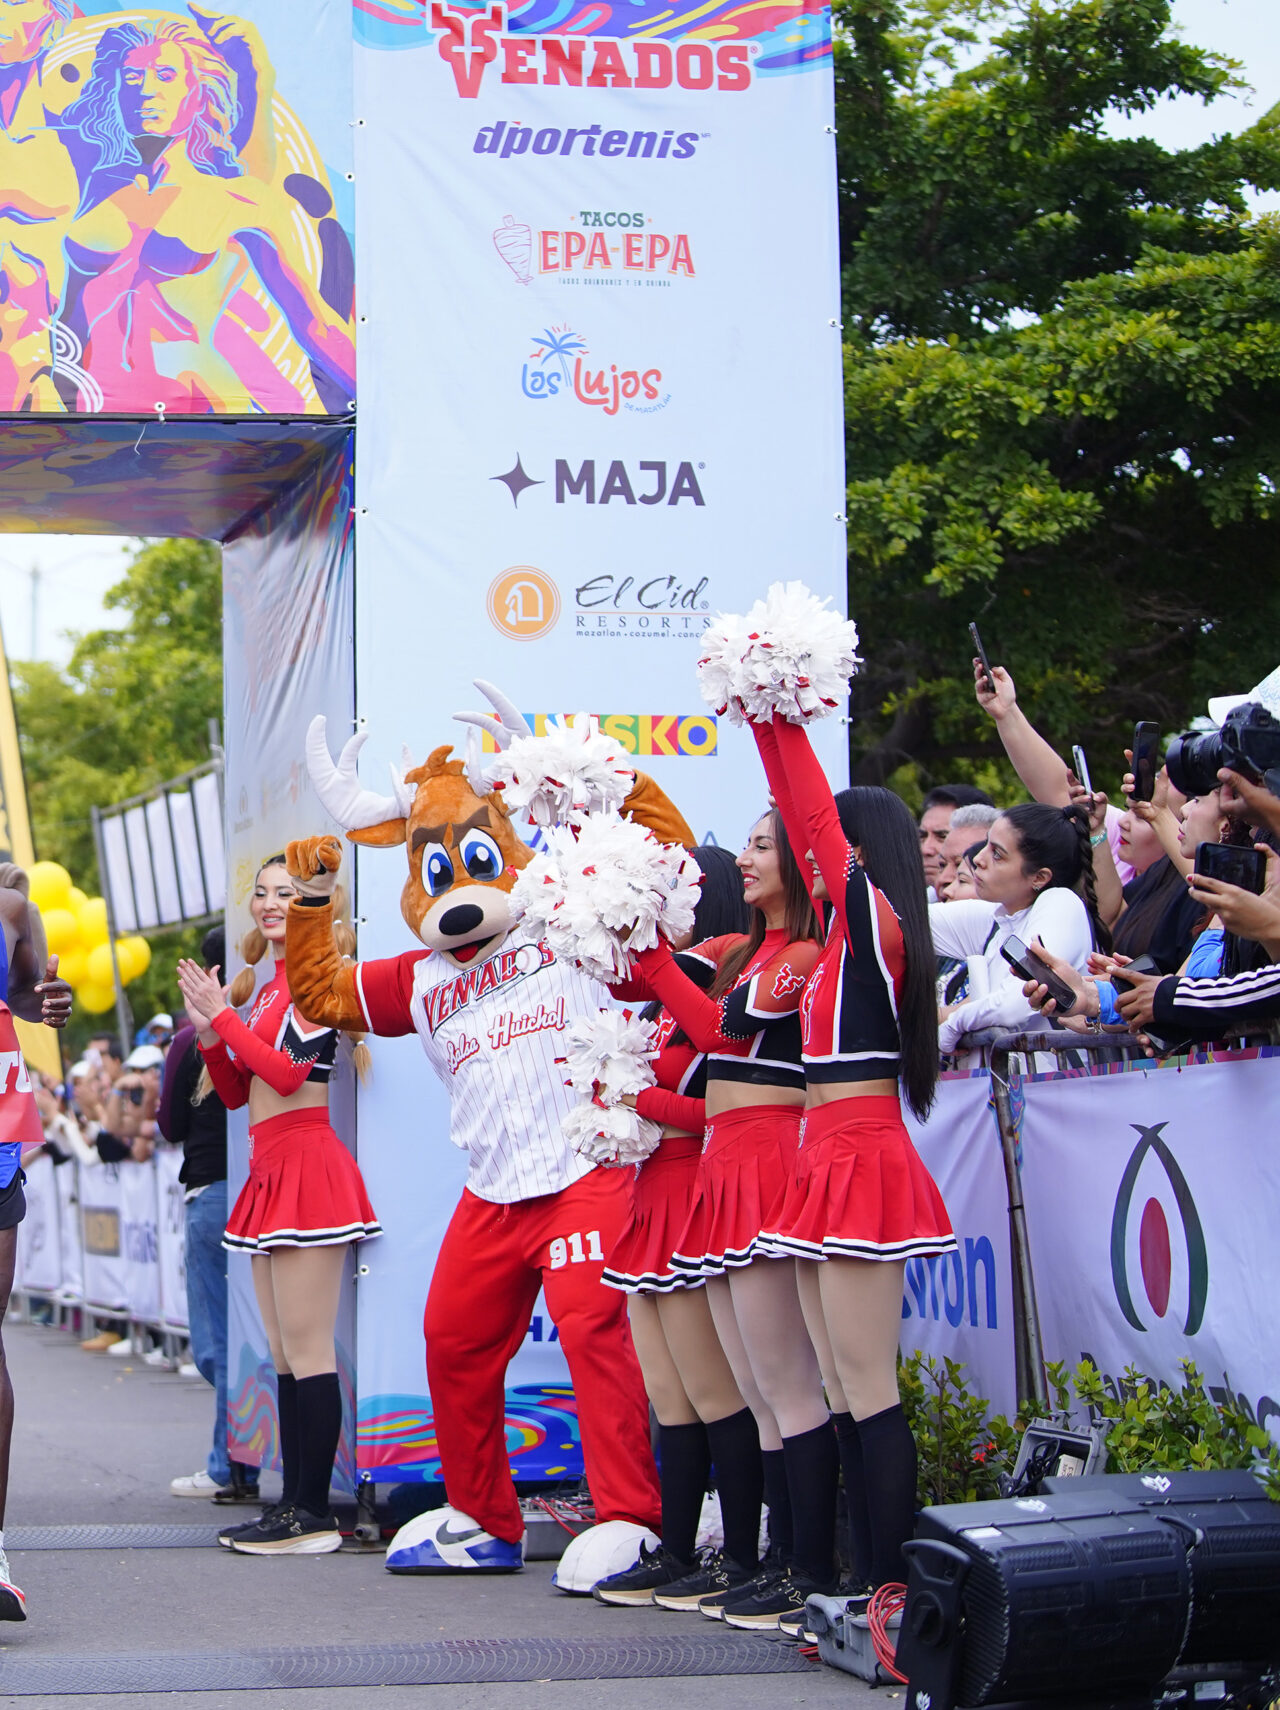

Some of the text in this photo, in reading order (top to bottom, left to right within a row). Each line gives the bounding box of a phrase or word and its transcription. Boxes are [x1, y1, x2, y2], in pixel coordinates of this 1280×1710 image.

[579, 211, 645, 228] TACOS
[538, 230, 697, 279] EPA-EPA
[522, 357, 662, 416] Los Lujos
[554, 458, 706, 507] MAJA
[575, 574, 710, 610] El Cid
[575, 615, 712, 629] RESORTS
[576, 628, 622, 638] mazatlan
[629, 629, 670, 639] cozumel
[446, 995, 566, 1075] Salsa Huichol
[548, 1230, 605, 1270] 911
